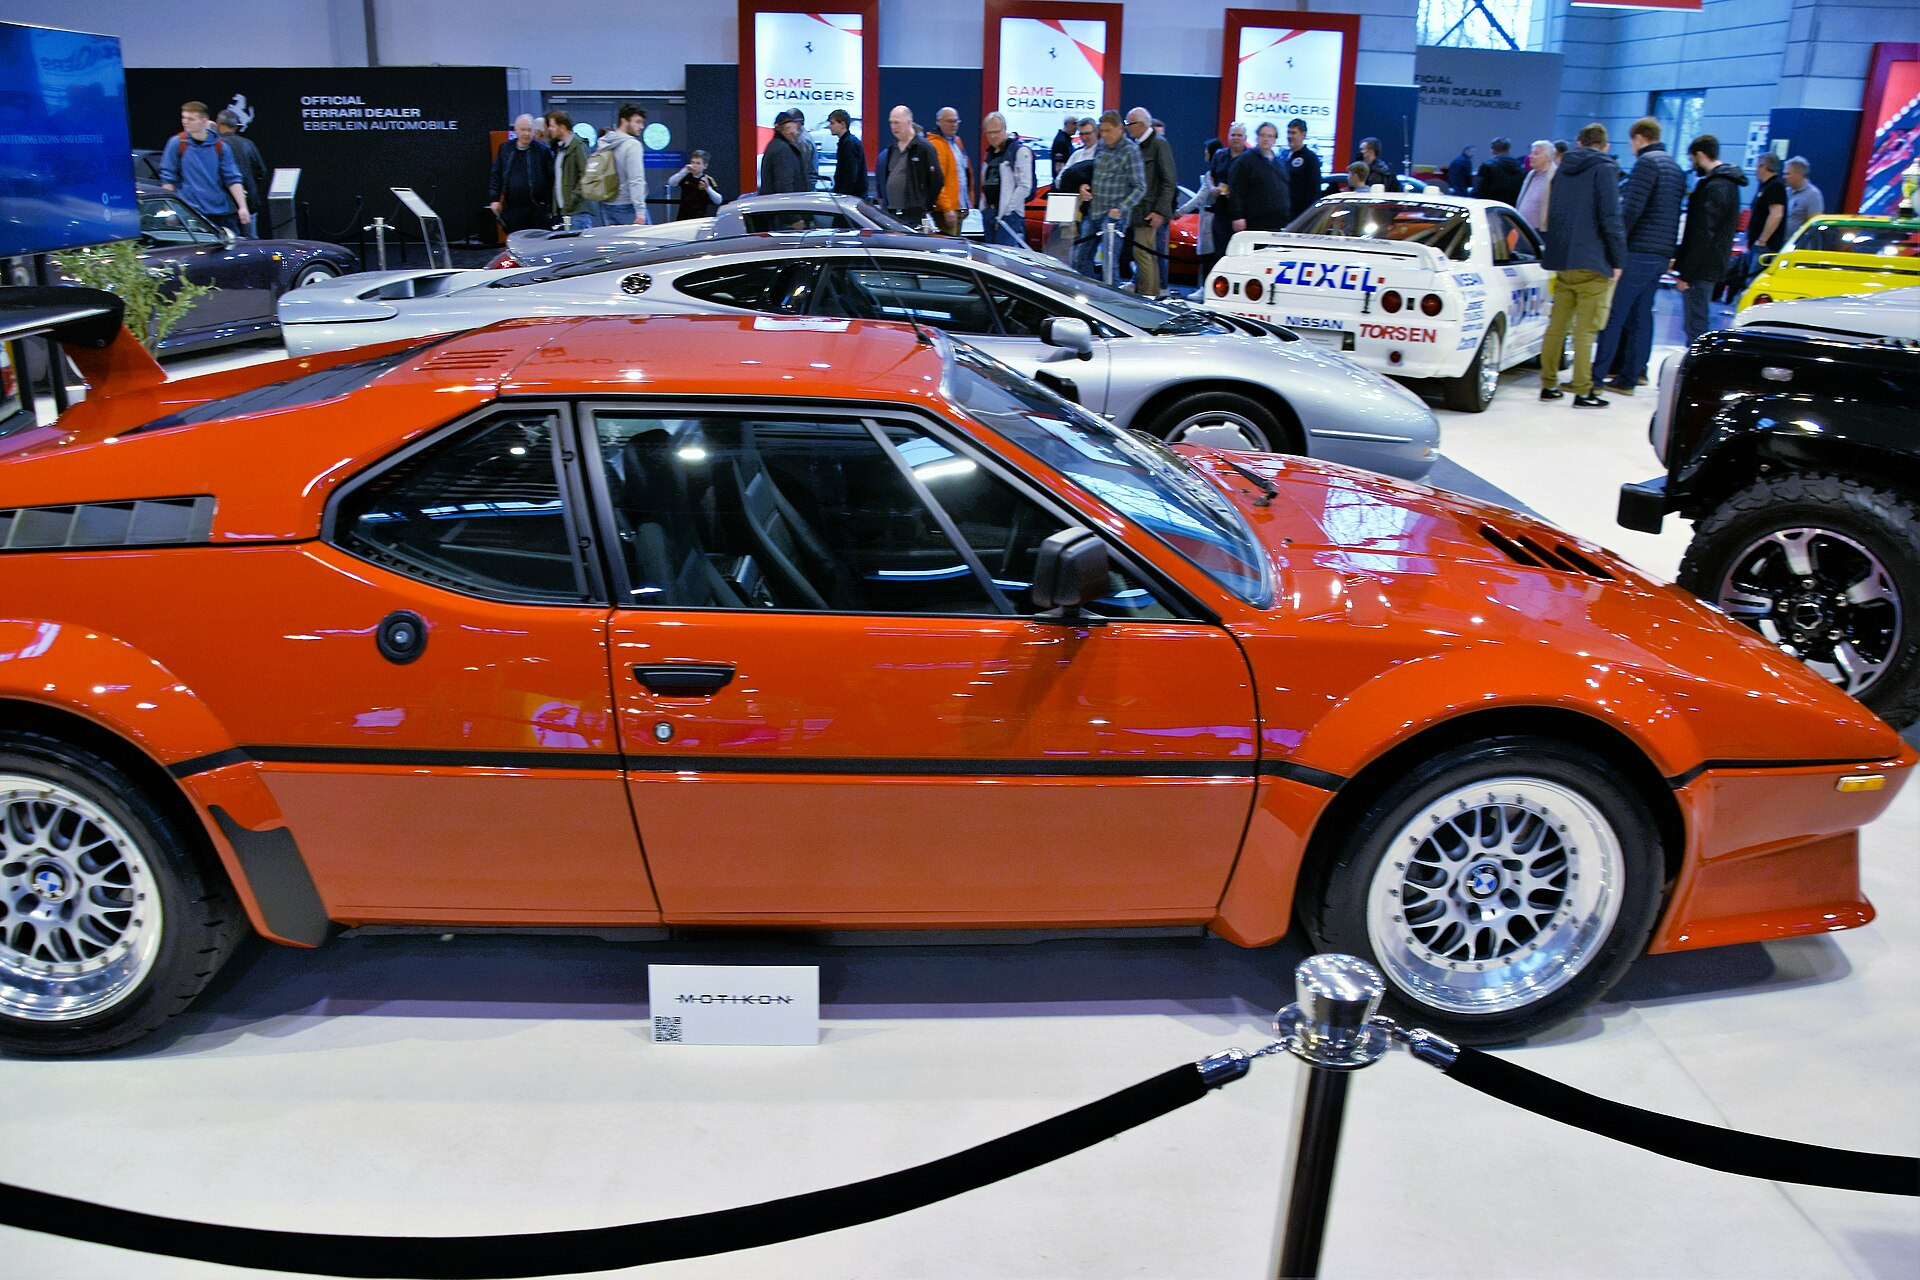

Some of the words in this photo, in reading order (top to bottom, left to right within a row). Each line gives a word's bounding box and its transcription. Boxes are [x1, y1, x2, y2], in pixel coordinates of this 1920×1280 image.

[764, 78, 812, 88] GAME
[1414, 75, 1452, 84] FICIAL
[764, 90, 855, 101] CHANGERS
[1007, 86, 1054, 96] GAME
[1419, 85, 1449, 95] RARI
[1452, 87, 1502, 97] DEALER
[300, 96, 366, 105] OFFICIAL
[1244, 92, 1290, 102] GAME
[1006, 98, 1096, 109] CHANGERS
[301, 108, 363, 118] FERRARI
[365, 108, 421, 118] DEALER
[1243, 103, 1330, 116] CHANGERS
[303, 121, 368, 131] EBERLEIN
[370, 120, 458, 131] AUTOMOBILE
[1275, 261, 1377, 293] ZEXEL
[1286, 315, 1344, 330] NISSAN
[1360, 323, 1436, 343] TORSEN
[675, 994, 794, 1005] MOTIKON
